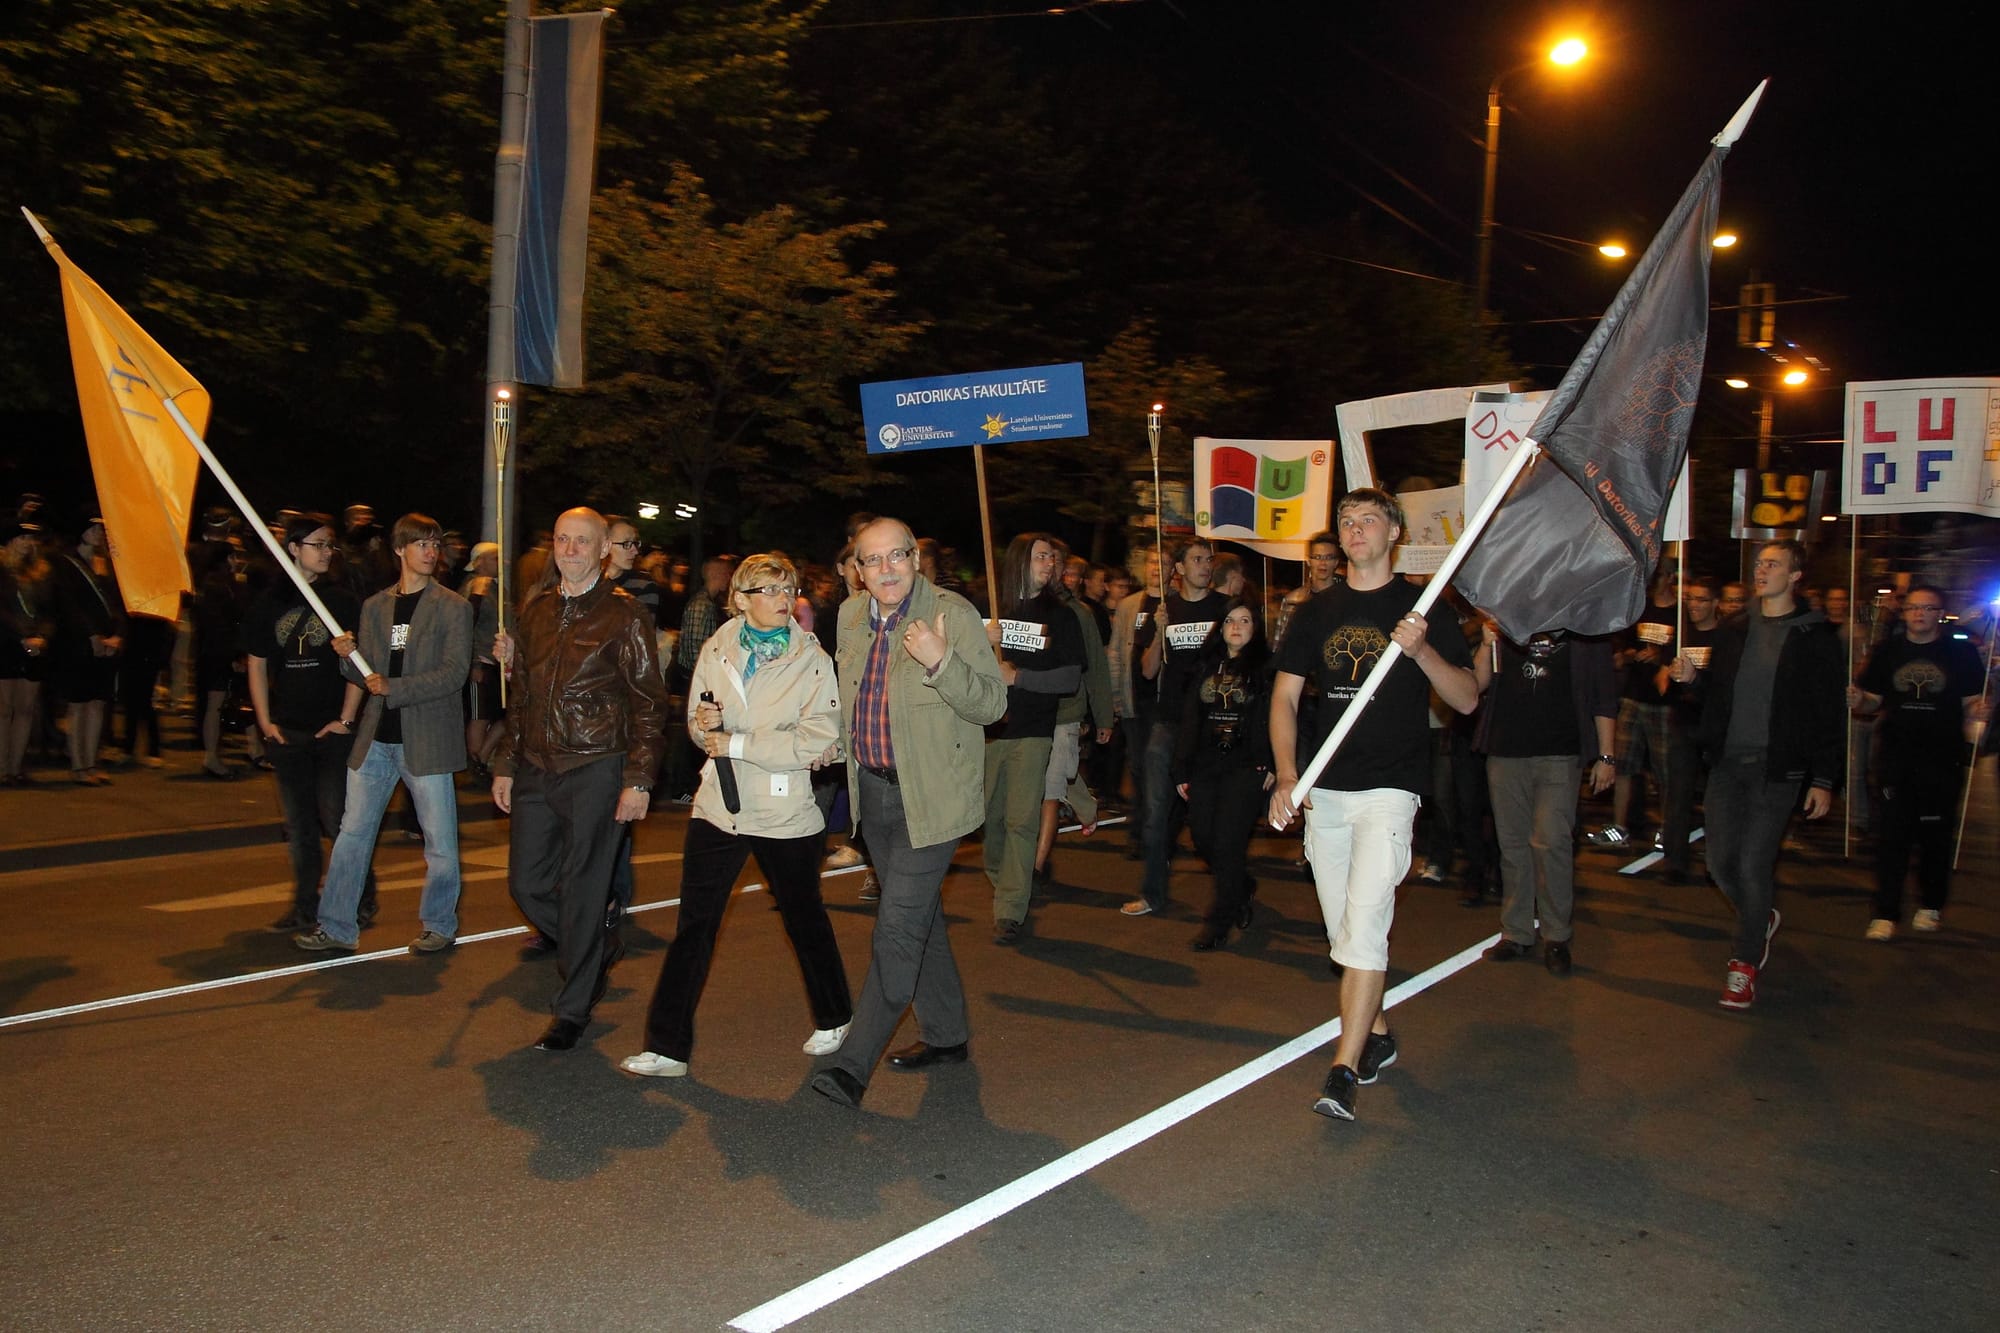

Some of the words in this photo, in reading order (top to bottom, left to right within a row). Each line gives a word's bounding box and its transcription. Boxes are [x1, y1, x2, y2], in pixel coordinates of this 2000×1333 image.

[896, 386, 970, 407] DATORIKAS
[973, 379, 1047, 399] FAKULTĀTE
[1471, 410, 1521, 451] DF
[1598, 479, 1645, 537] Datorikas
[1000, 621, 1031, 632] ODĒJU
[1174, 624, 1208, 633] KODĒJU
[1005, 633, 1042, 646] KODĒTU
